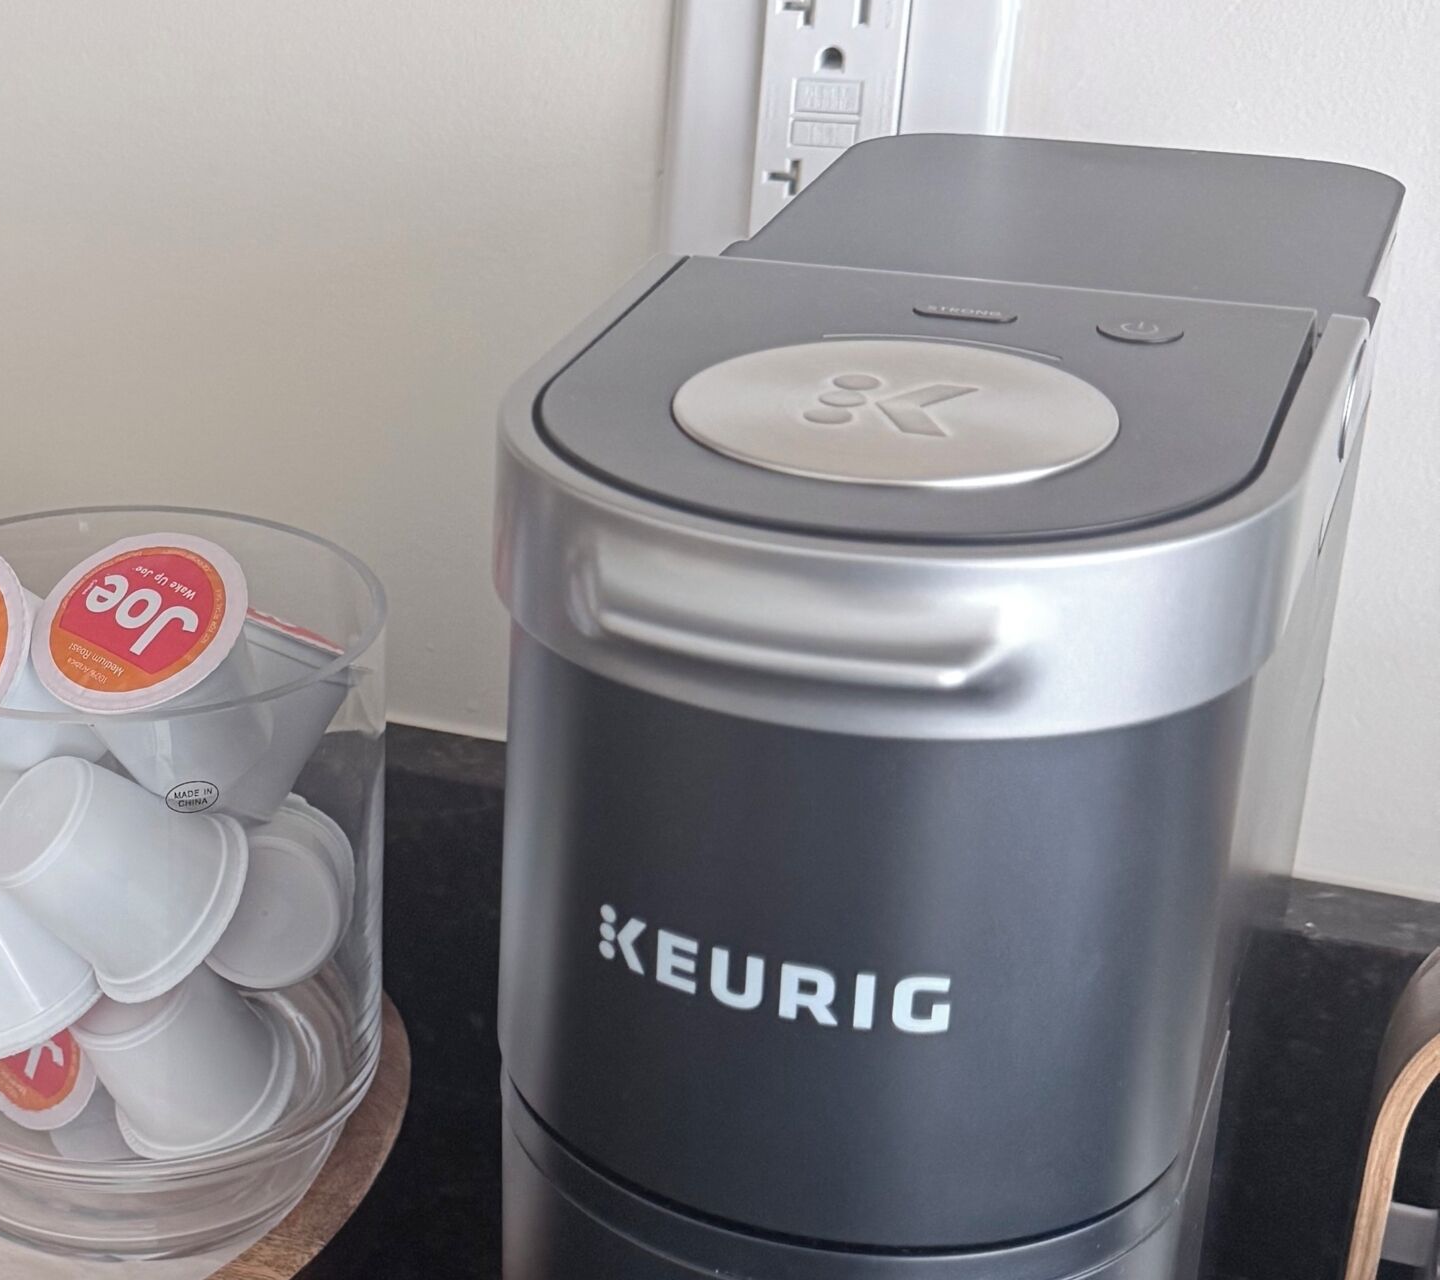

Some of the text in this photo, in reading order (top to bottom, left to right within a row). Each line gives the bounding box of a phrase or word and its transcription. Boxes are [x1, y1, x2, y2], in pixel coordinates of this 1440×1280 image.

[153, 573, 170, 589] Up
[170, 580, 196, 601] Wake
[84, 574, 200, 656] Joe
[68, 642, 125, 677] Medium Roast
[174, 787, 213, 799] MADE IN
[178, 797, 208, 808] CHINA
[599, 902, 952, 1034] KEURIG
